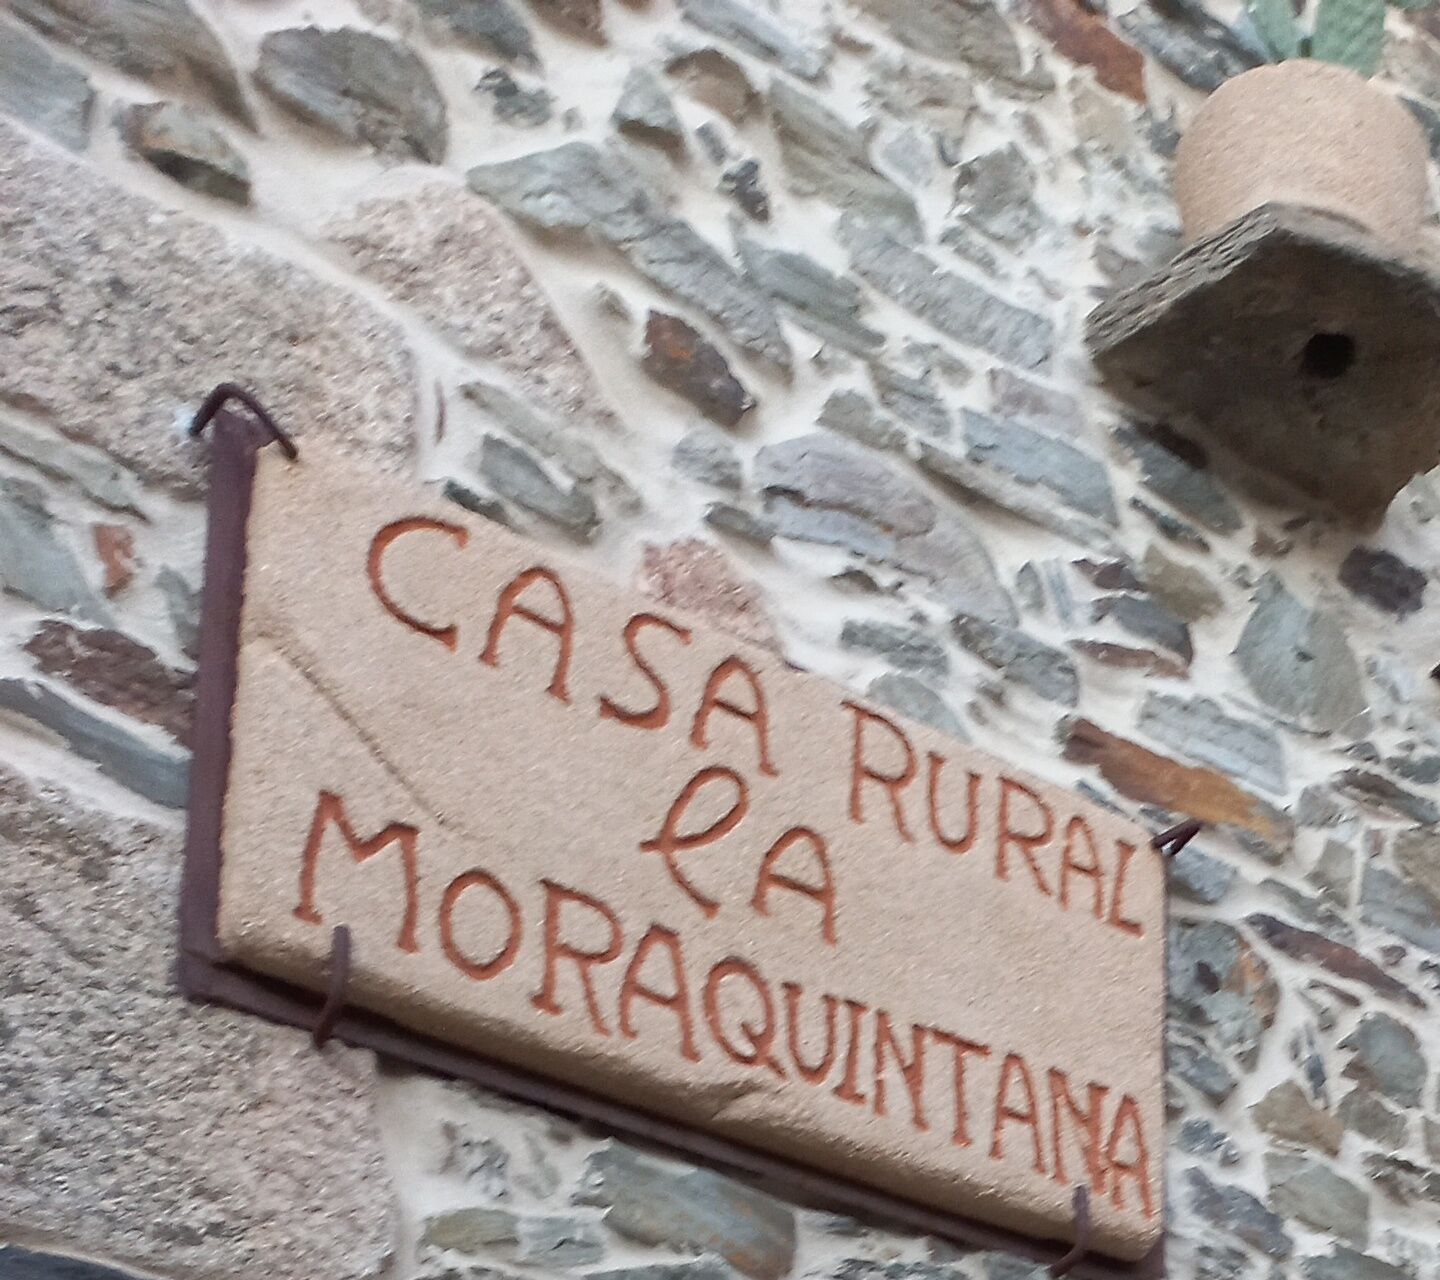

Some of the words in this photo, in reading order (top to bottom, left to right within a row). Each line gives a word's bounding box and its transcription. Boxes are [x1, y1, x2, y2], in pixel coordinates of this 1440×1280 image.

[364, 514, 779, 777] CASA
[841, 700, 1145, 938] RURAL
[293, 789, 1154, 1216] MORAQUINTANA
